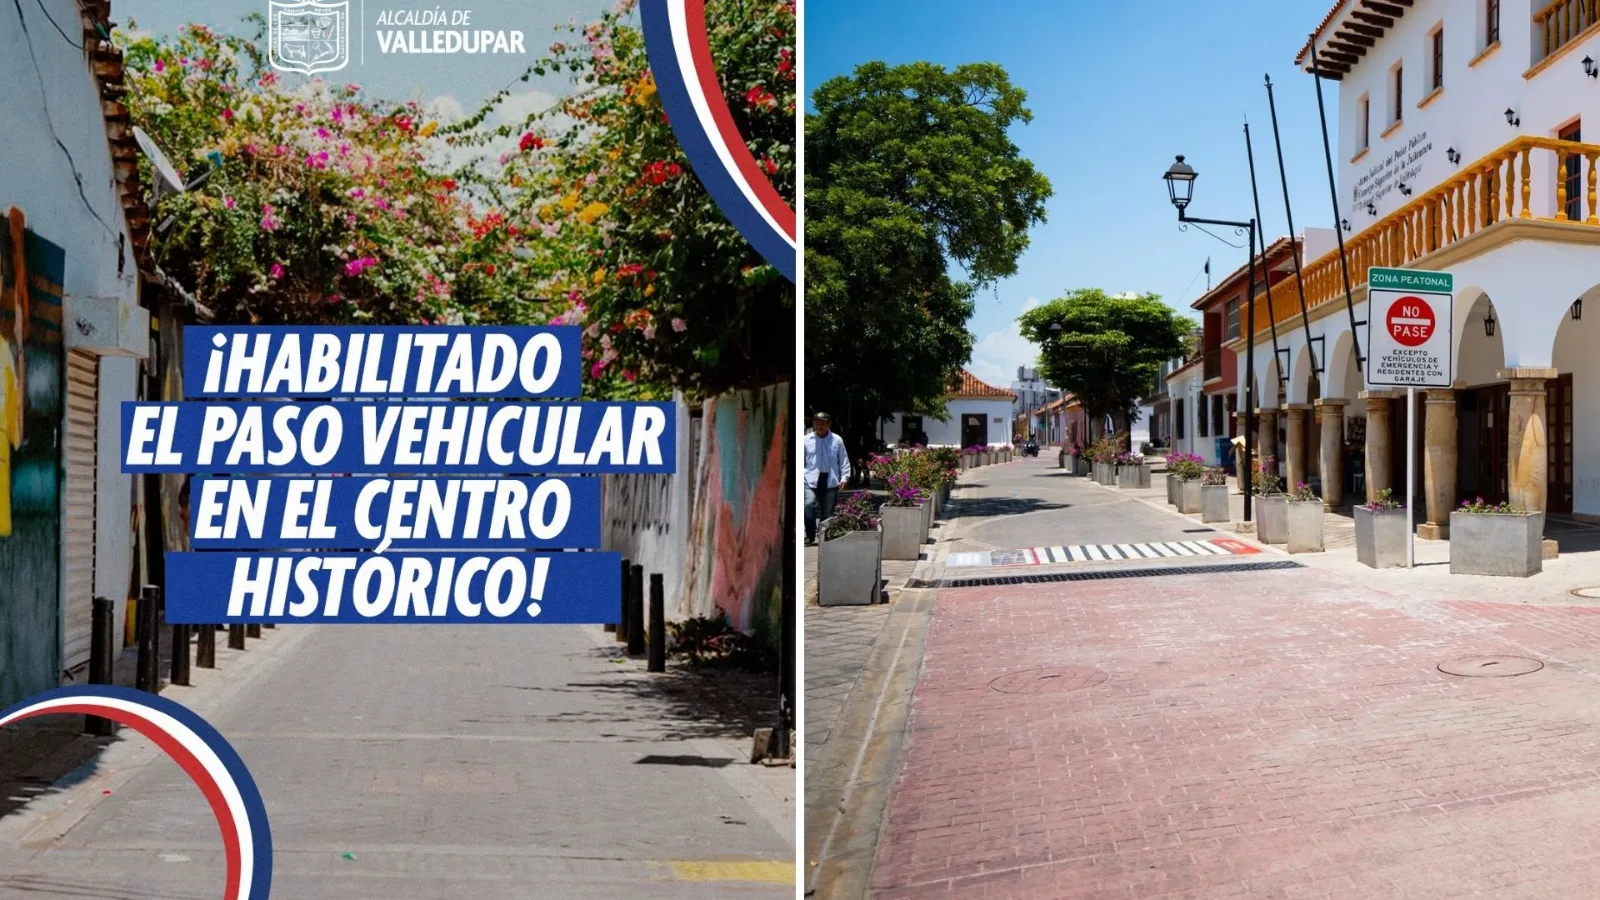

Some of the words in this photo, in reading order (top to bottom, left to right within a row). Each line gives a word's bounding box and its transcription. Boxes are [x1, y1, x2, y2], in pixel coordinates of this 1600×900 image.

[1372, 273, 1399, 283] ZONA
[1401, 275, 1450, 287] PEATONAL
[1402, 305, 1420, 317] NO
[1393, 325, 1428, 338] PASE
[1382, 355, 1426, 363] VEHÍCULOS
[1377, 368, 1425, 376] RESIDENTES
[1394, 375, 1426, 383] GARAJE
